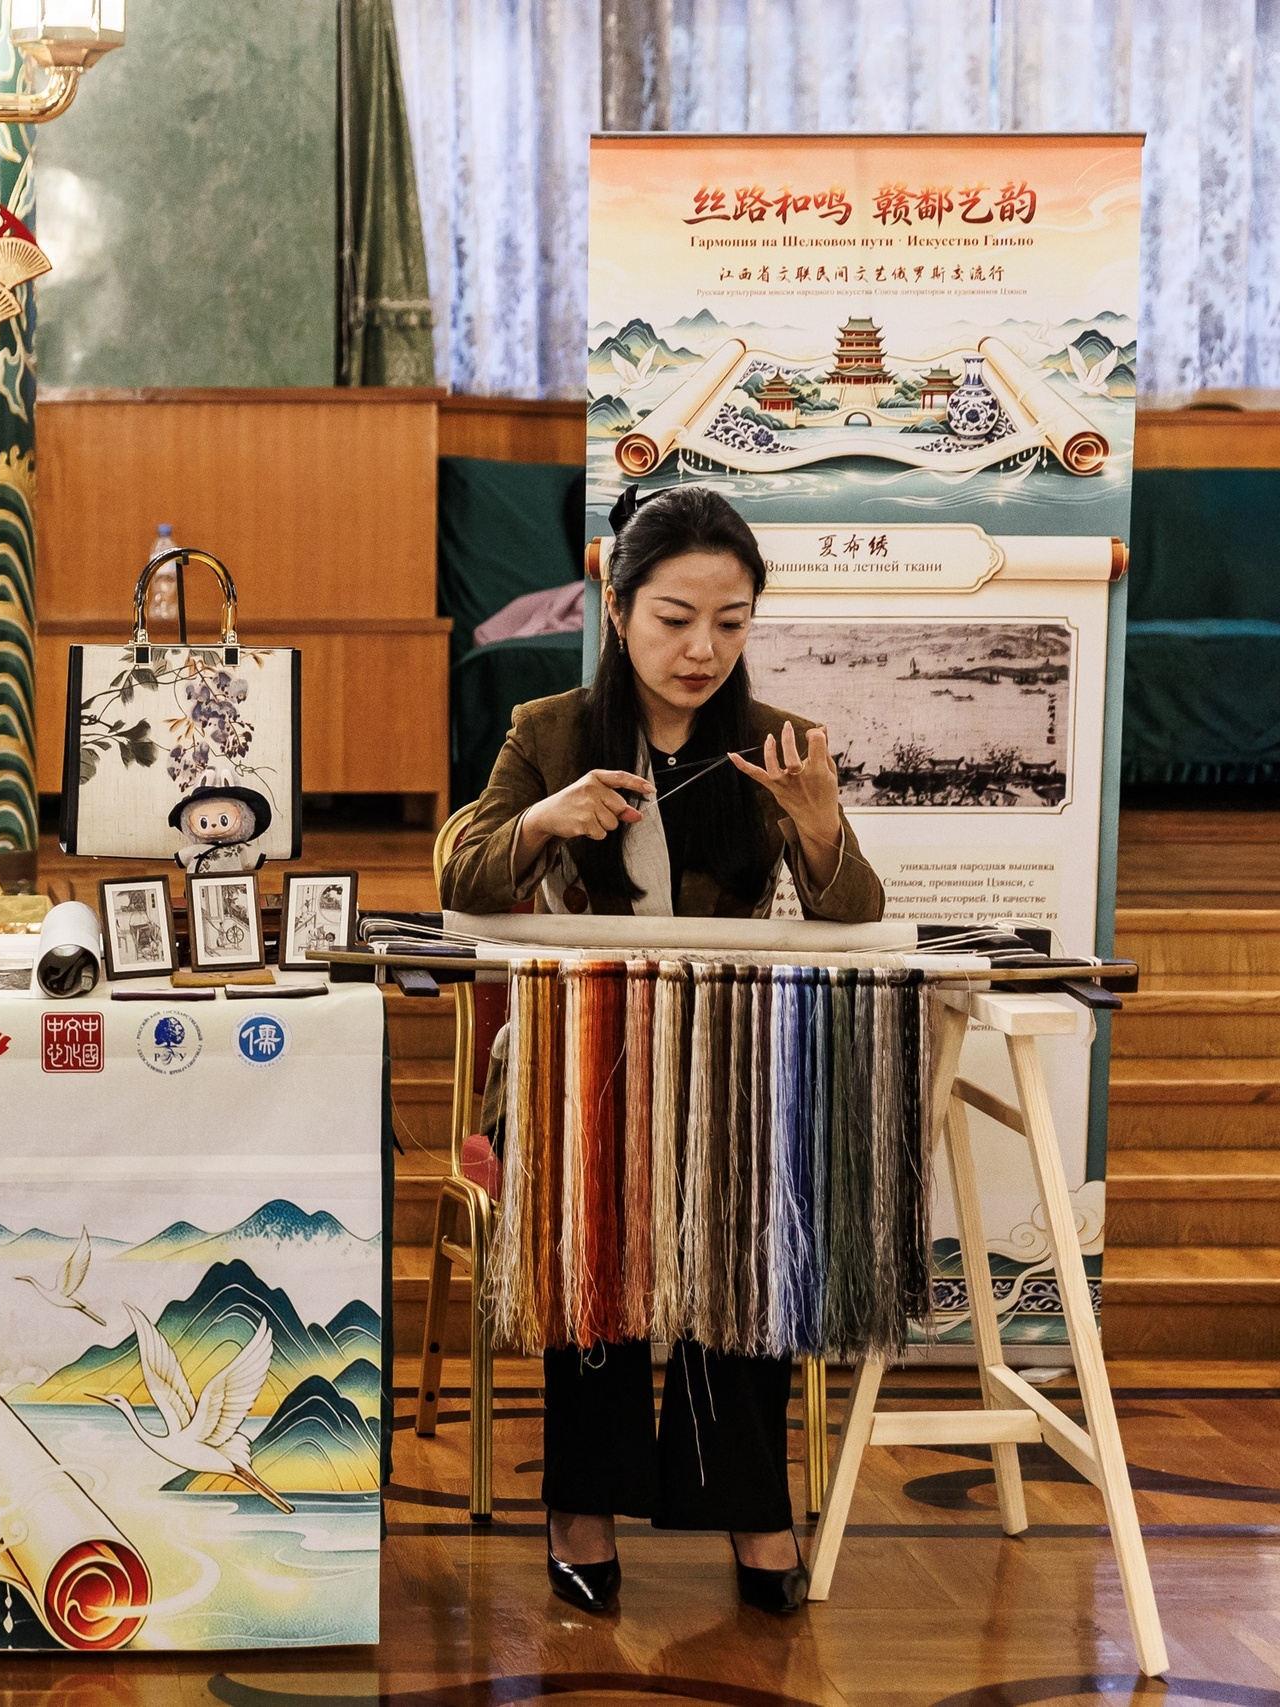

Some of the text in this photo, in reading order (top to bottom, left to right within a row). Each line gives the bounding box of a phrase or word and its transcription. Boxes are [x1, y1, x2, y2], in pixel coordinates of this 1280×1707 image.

[682, 180, 1037, 229] 丝路和鸣 赣鄱艺韵
[690, 234, 1034, 250] Гармония на Шелковом пути Искусство Ганьпо
[818, 534, 888, 559] 夏布绣
[765, 560, 942, 572] Вышивка на летней ткани
[900, 863, 1055, 872] уникальная народная вышивка
[929, 879, 983, 889] провинции
[884, 894, 937, 903] ячелетней
[992, 894, 1000, 903] В
[1002, 895, 1047, 903] качестве
[908, 911, 974, 921] используется
[241, 1024, 281, 1056] 儒
